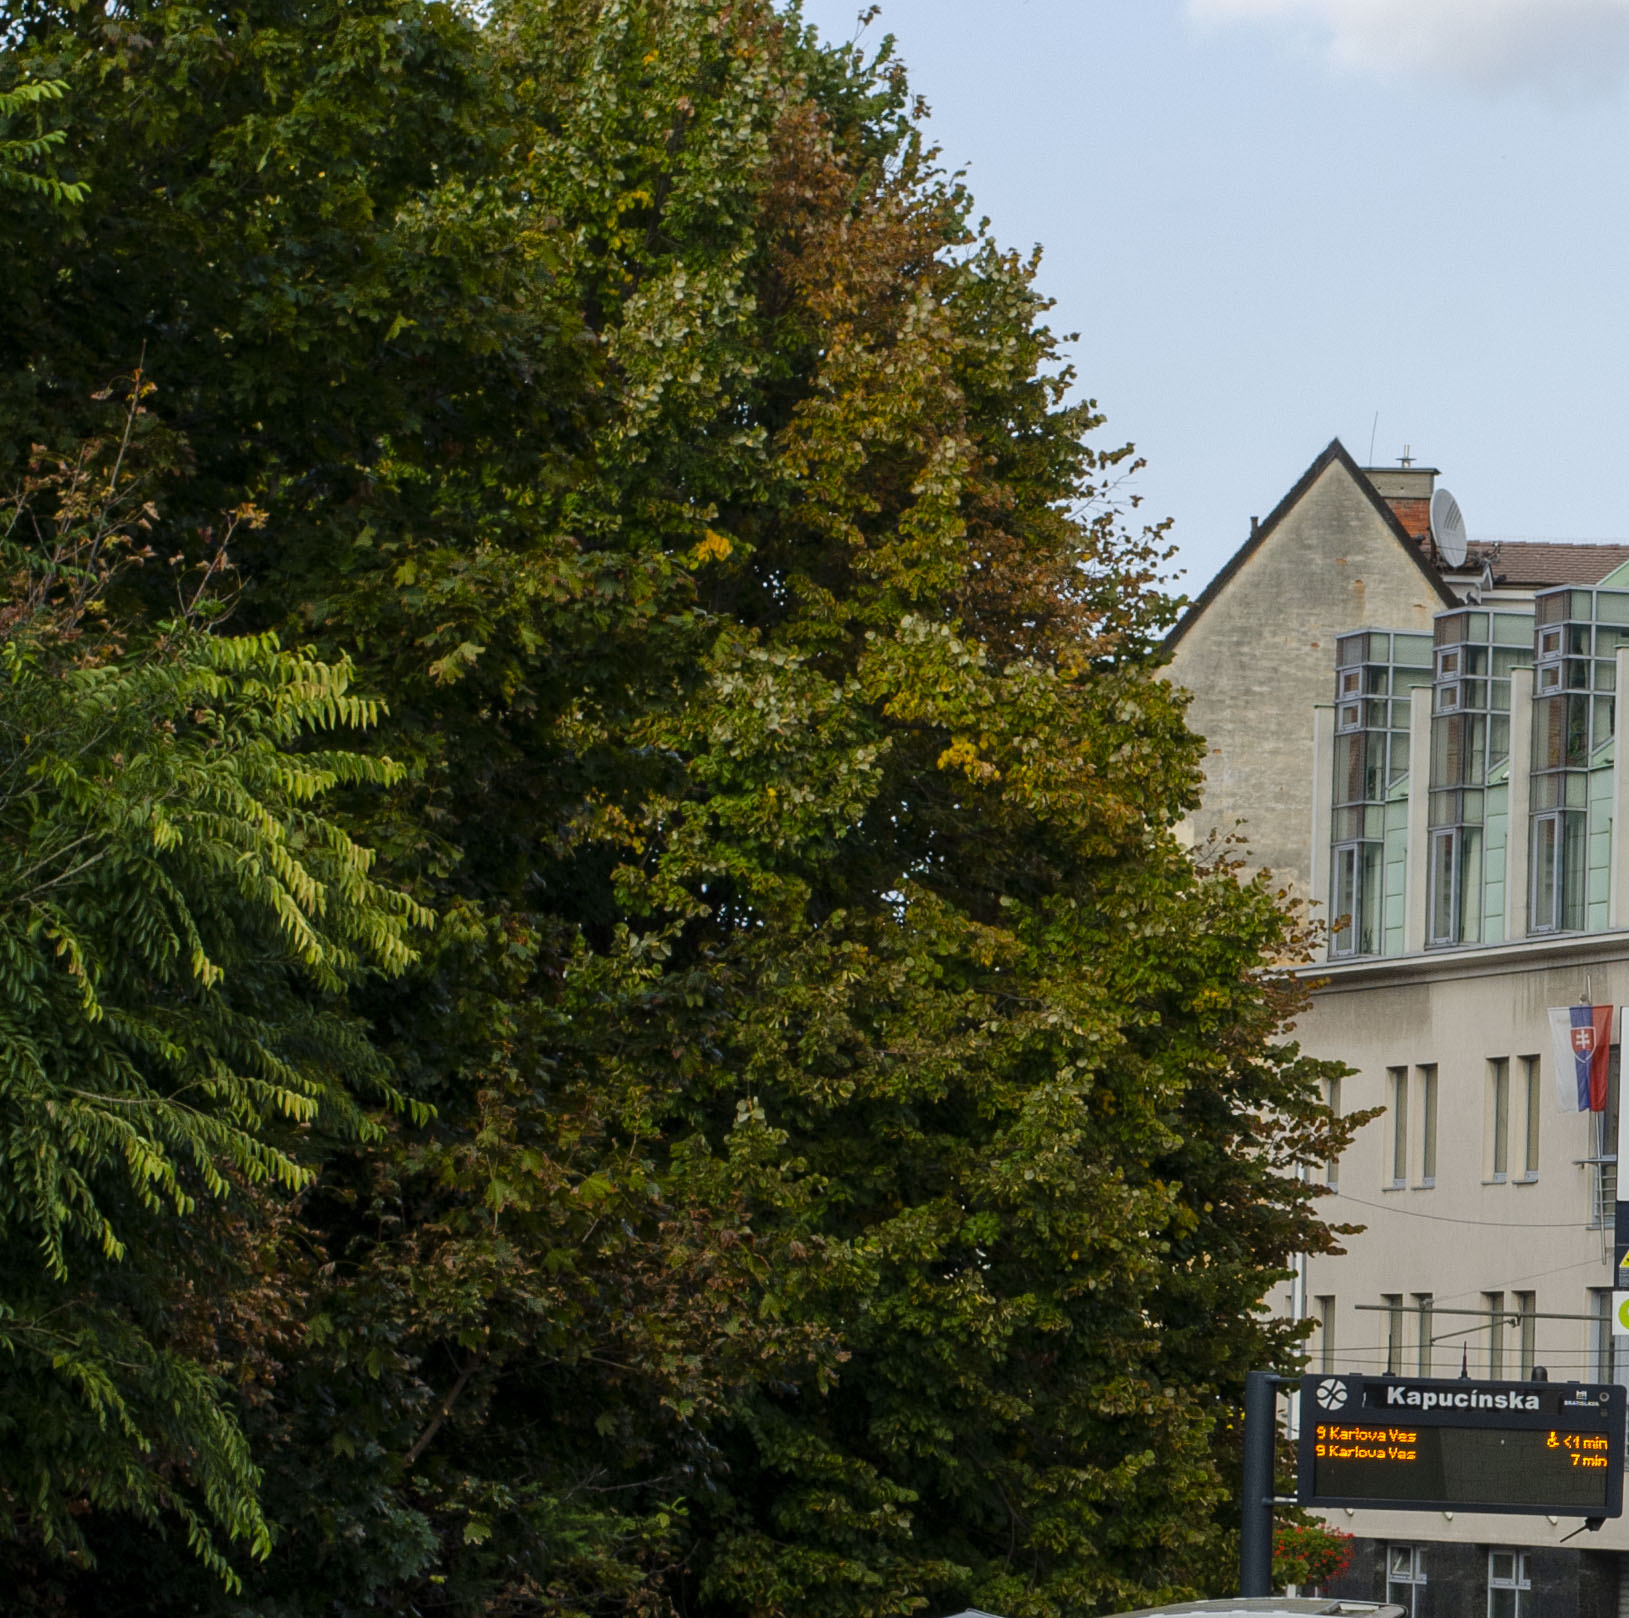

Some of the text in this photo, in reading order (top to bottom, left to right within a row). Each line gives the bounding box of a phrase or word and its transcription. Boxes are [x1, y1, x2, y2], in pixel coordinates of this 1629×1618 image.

[1386, 1385, 1540, 1411] Kapucínska
[1316, 1426, 1327, 1440] 9
[1329, 1426, 1387, 1442] Karlova
[1583, 1436, 1608, 1450] min
[1315, 1444, 1326, 1457] 9
[1328, 1445, 1386, 1459] Karlova
[1570, 1453, 1581, 1466] 7
[1582, 1454, 1608, 1467] min
